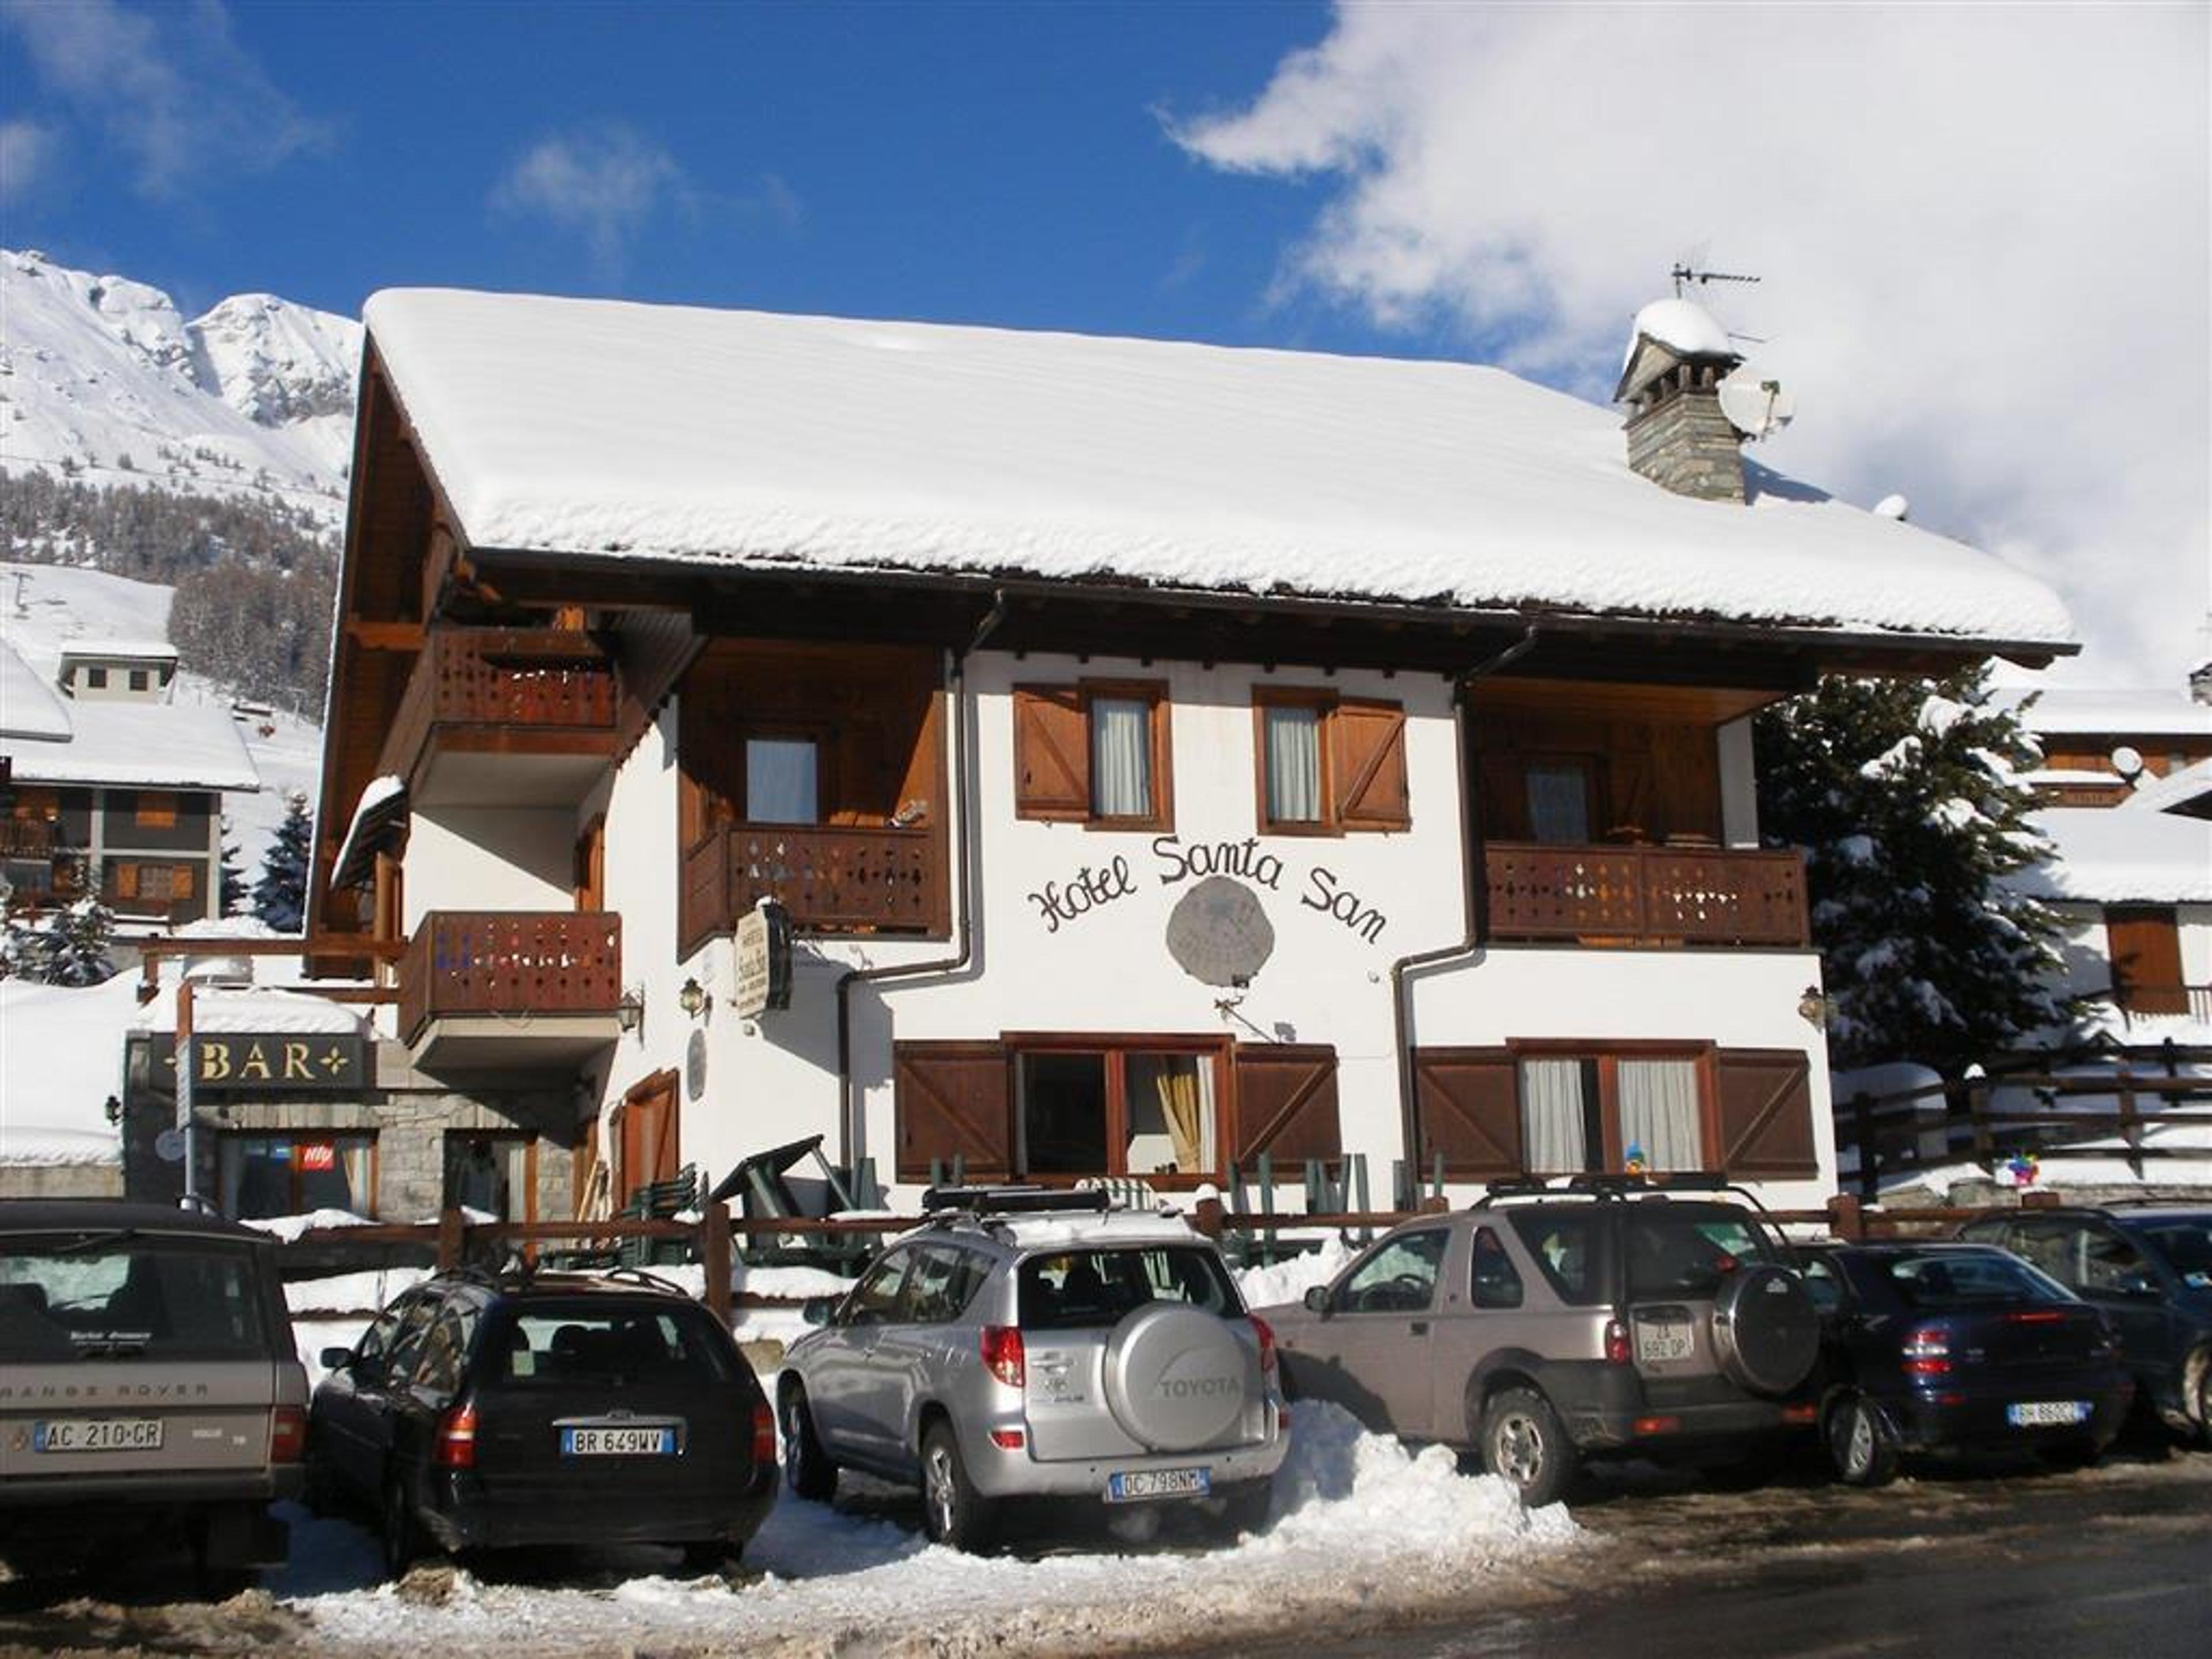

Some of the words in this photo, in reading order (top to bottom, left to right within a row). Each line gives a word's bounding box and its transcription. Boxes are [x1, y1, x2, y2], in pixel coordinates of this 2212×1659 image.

[1028, 855, 1137, 933] Hotel
[1153, 835, 1283, 890] Santa
[1301, 867, 1386, 945] San
[202, 1043, 316, 1080] BAR
[118, 1384, 207, 1396] ROVER
[1159, 1377, 1242, 1400] TOYOTA
[47, 1426, 74, 1446] AC
[576, 1432, 597, 1452] BR
